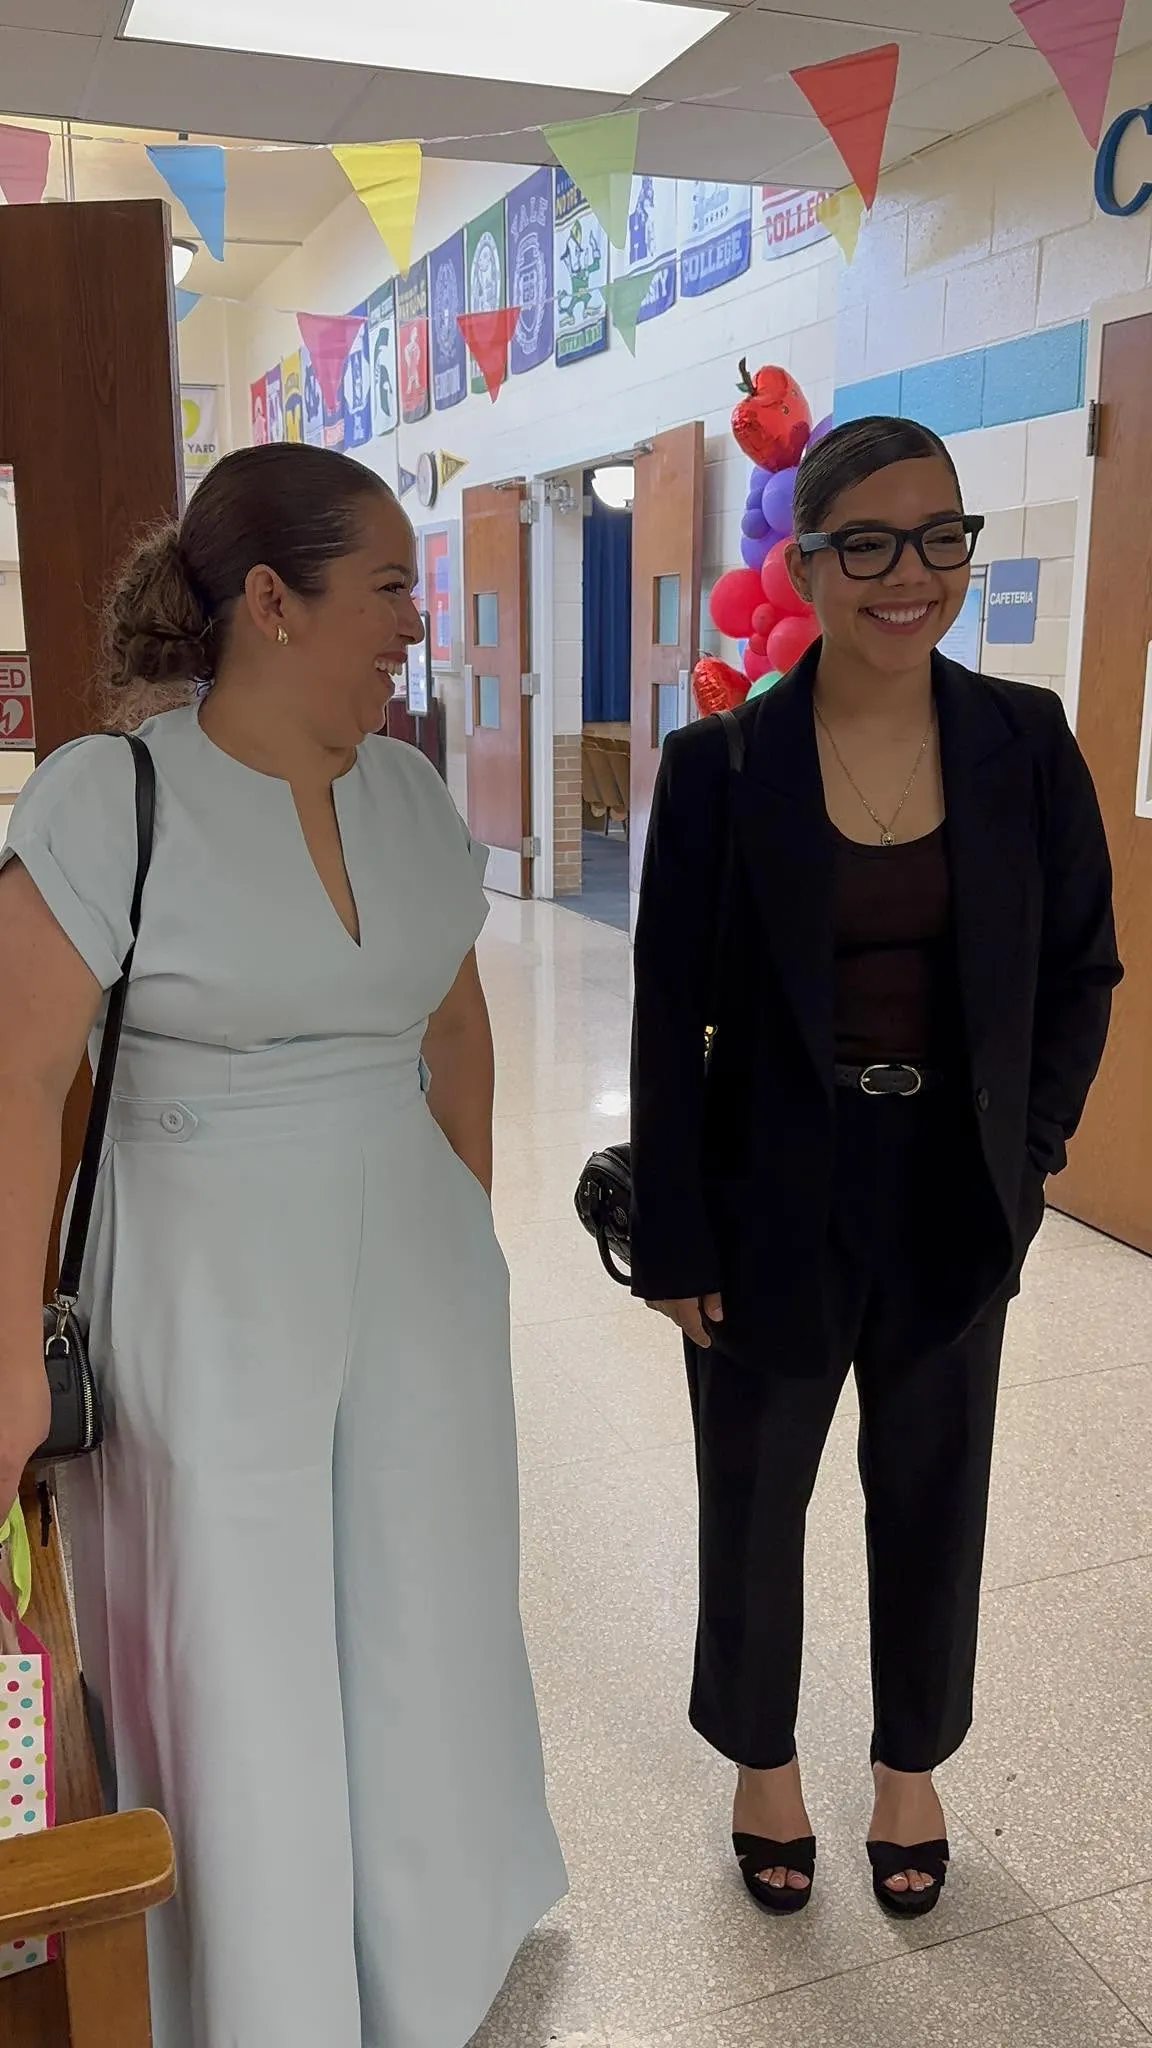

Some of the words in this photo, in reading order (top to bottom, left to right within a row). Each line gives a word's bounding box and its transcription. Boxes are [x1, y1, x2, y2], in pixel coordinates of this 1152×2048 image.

[1094, 103, 1152, 217] C
[766, 189, 839, 247] COLLE
[682, 228, 742, 285] COLLEGE
[187, 443, 216, 454] YARD
[989, 591, 1033, 606] CAFETERIA
